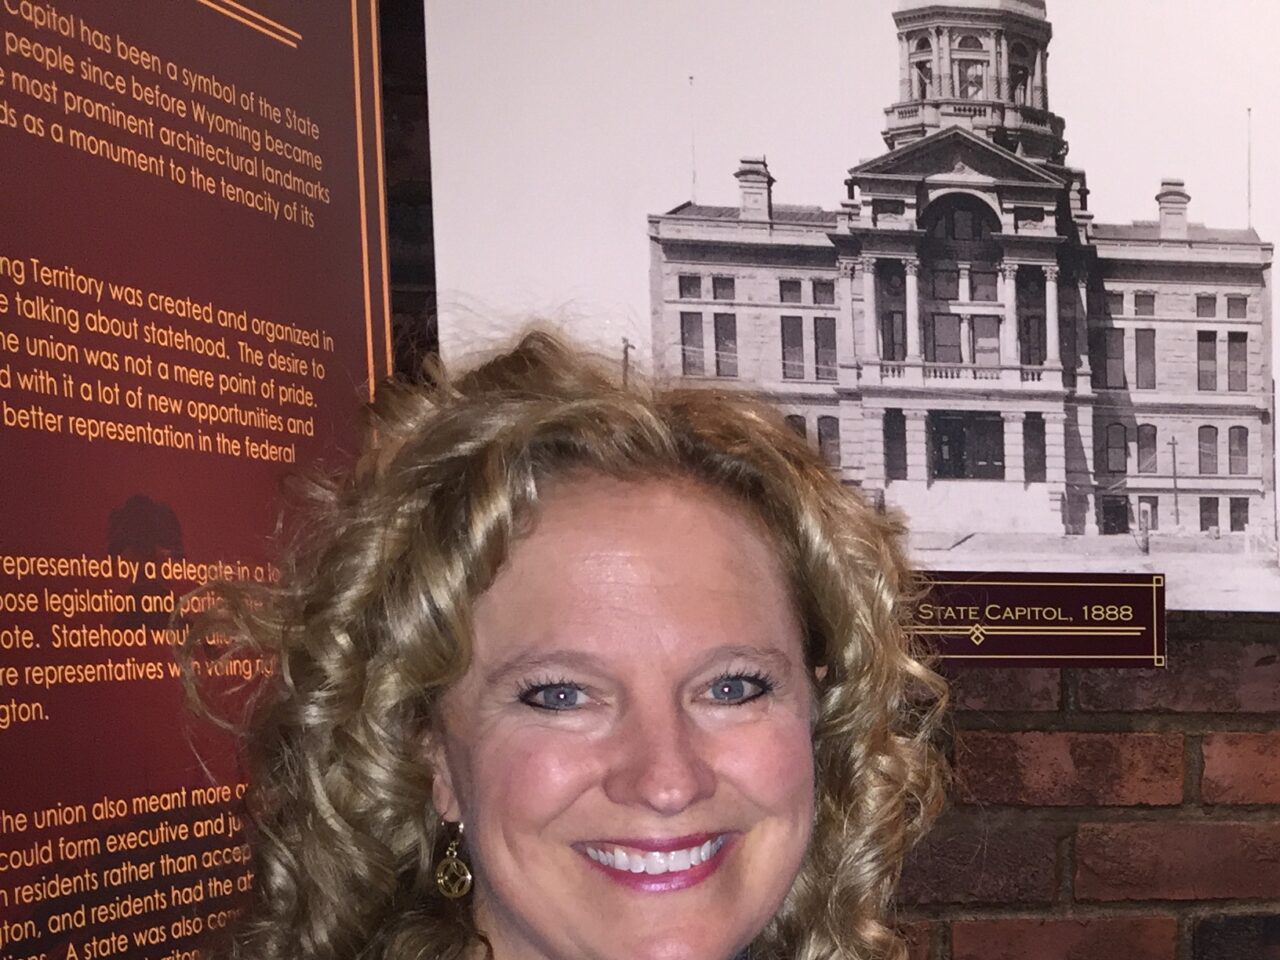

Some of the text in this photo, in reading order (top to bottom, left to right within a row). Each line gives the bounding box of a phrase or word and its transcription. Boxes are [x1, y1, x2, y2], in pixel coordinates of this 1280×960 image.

[4, 0, 319, 139] Capitol has been a symbol of the State
[5, 31, 322, 171] people since before Wyoming became
[12, 71, 330, 203] most prominent architectural landmarks
[23, 114, 44, 137] as
[51, 123, 63, 143] a
[70, 128, 164, 177] monument
[169, 158, 186, 184] to
[190, 166, 216, 194] the
[220, 177, 279, 220] tenacity
[284, 202, 297, 222] of
[301, 205, 314, 228] its
[15, 291, 79, 334] talking
[85, 309, 138, 340] about
[144, 321, 230, 360] statehood.
[238, 341, 263, 366] The
[268, 349, 308, 376] desire
[312, 358, 325, 379] to
[30, 258, 104, 302] Territory
[109, 283, 143, 307] was
[148, 293, 213, 323] created
[217, 310, 247, 331] and
[252, 318, 319, 348] organized
[323, 331, 334, 352] in
[26, 335, 78, 363] union
[83, 348, 119, 371] was
[124, 355, 152, 376] not
[158, 362, 169, 380] a
[174, 365, 214, 388] mere
[219, 372, 256, 396] point
[261, 379, 275, 399] of
[279, 383, 317, 407] pride.
[3, 401, 295, 463] better representation in the federal
[17, 370, 58, 396] with
[63, 373, 74, 398] it
[80, 383, 92, 401] a
[98, 380, 120, 405] lot
[126, 386, 142, 409] of
[148, 394, 182, 414] new
[187, 401, 283, 432] opportunities
[287, 417, 314, 436] and
[0, 554, 112, 580] epresented
[117, 555, 139, 584] by
[144, 561, 156, 579] a
[160, 557, 233, 585] delegate
[237, 560, 250, 581] in
[254, 566, 264, 582] a
[0, 592, 39, 613] ose
[44, 587, 136, 618] legislation
[141, 590, 175, 613] and
[918, 604, 980, 620] STATE
[985, 604, 1073, 622] CAPITOL,
[1081, 604, 1134, 621] 1888
[52, 624, 147, 648] Statehood
[25, 656, 164, 689] representatives
[34, 802, 86, 829] union
[92, 796, 127, 820] also
[132, 786, 186, 815] meant
[192, 786, 231, 806] more
[0, 840, 53, 871] could
[59, 837, 100, 860] form
[106, 821, 189, 853] executive
[193, 813, 224, 838] and
[15, 868, 98, 904] residents
[104, 861, 155, 887] rather
[160, 854, 197, 876] than
[0, 920, 41, 950] ton,
[48, 904, 86, 933] and
[91, 889, 167, 924] residents
[171, 880, 204, 906] had
[208, 877, 233, 898] the
[84, 932, 128, 960] state
[133, 925, 167, 947] was
[171, 916, 203, 939] also
